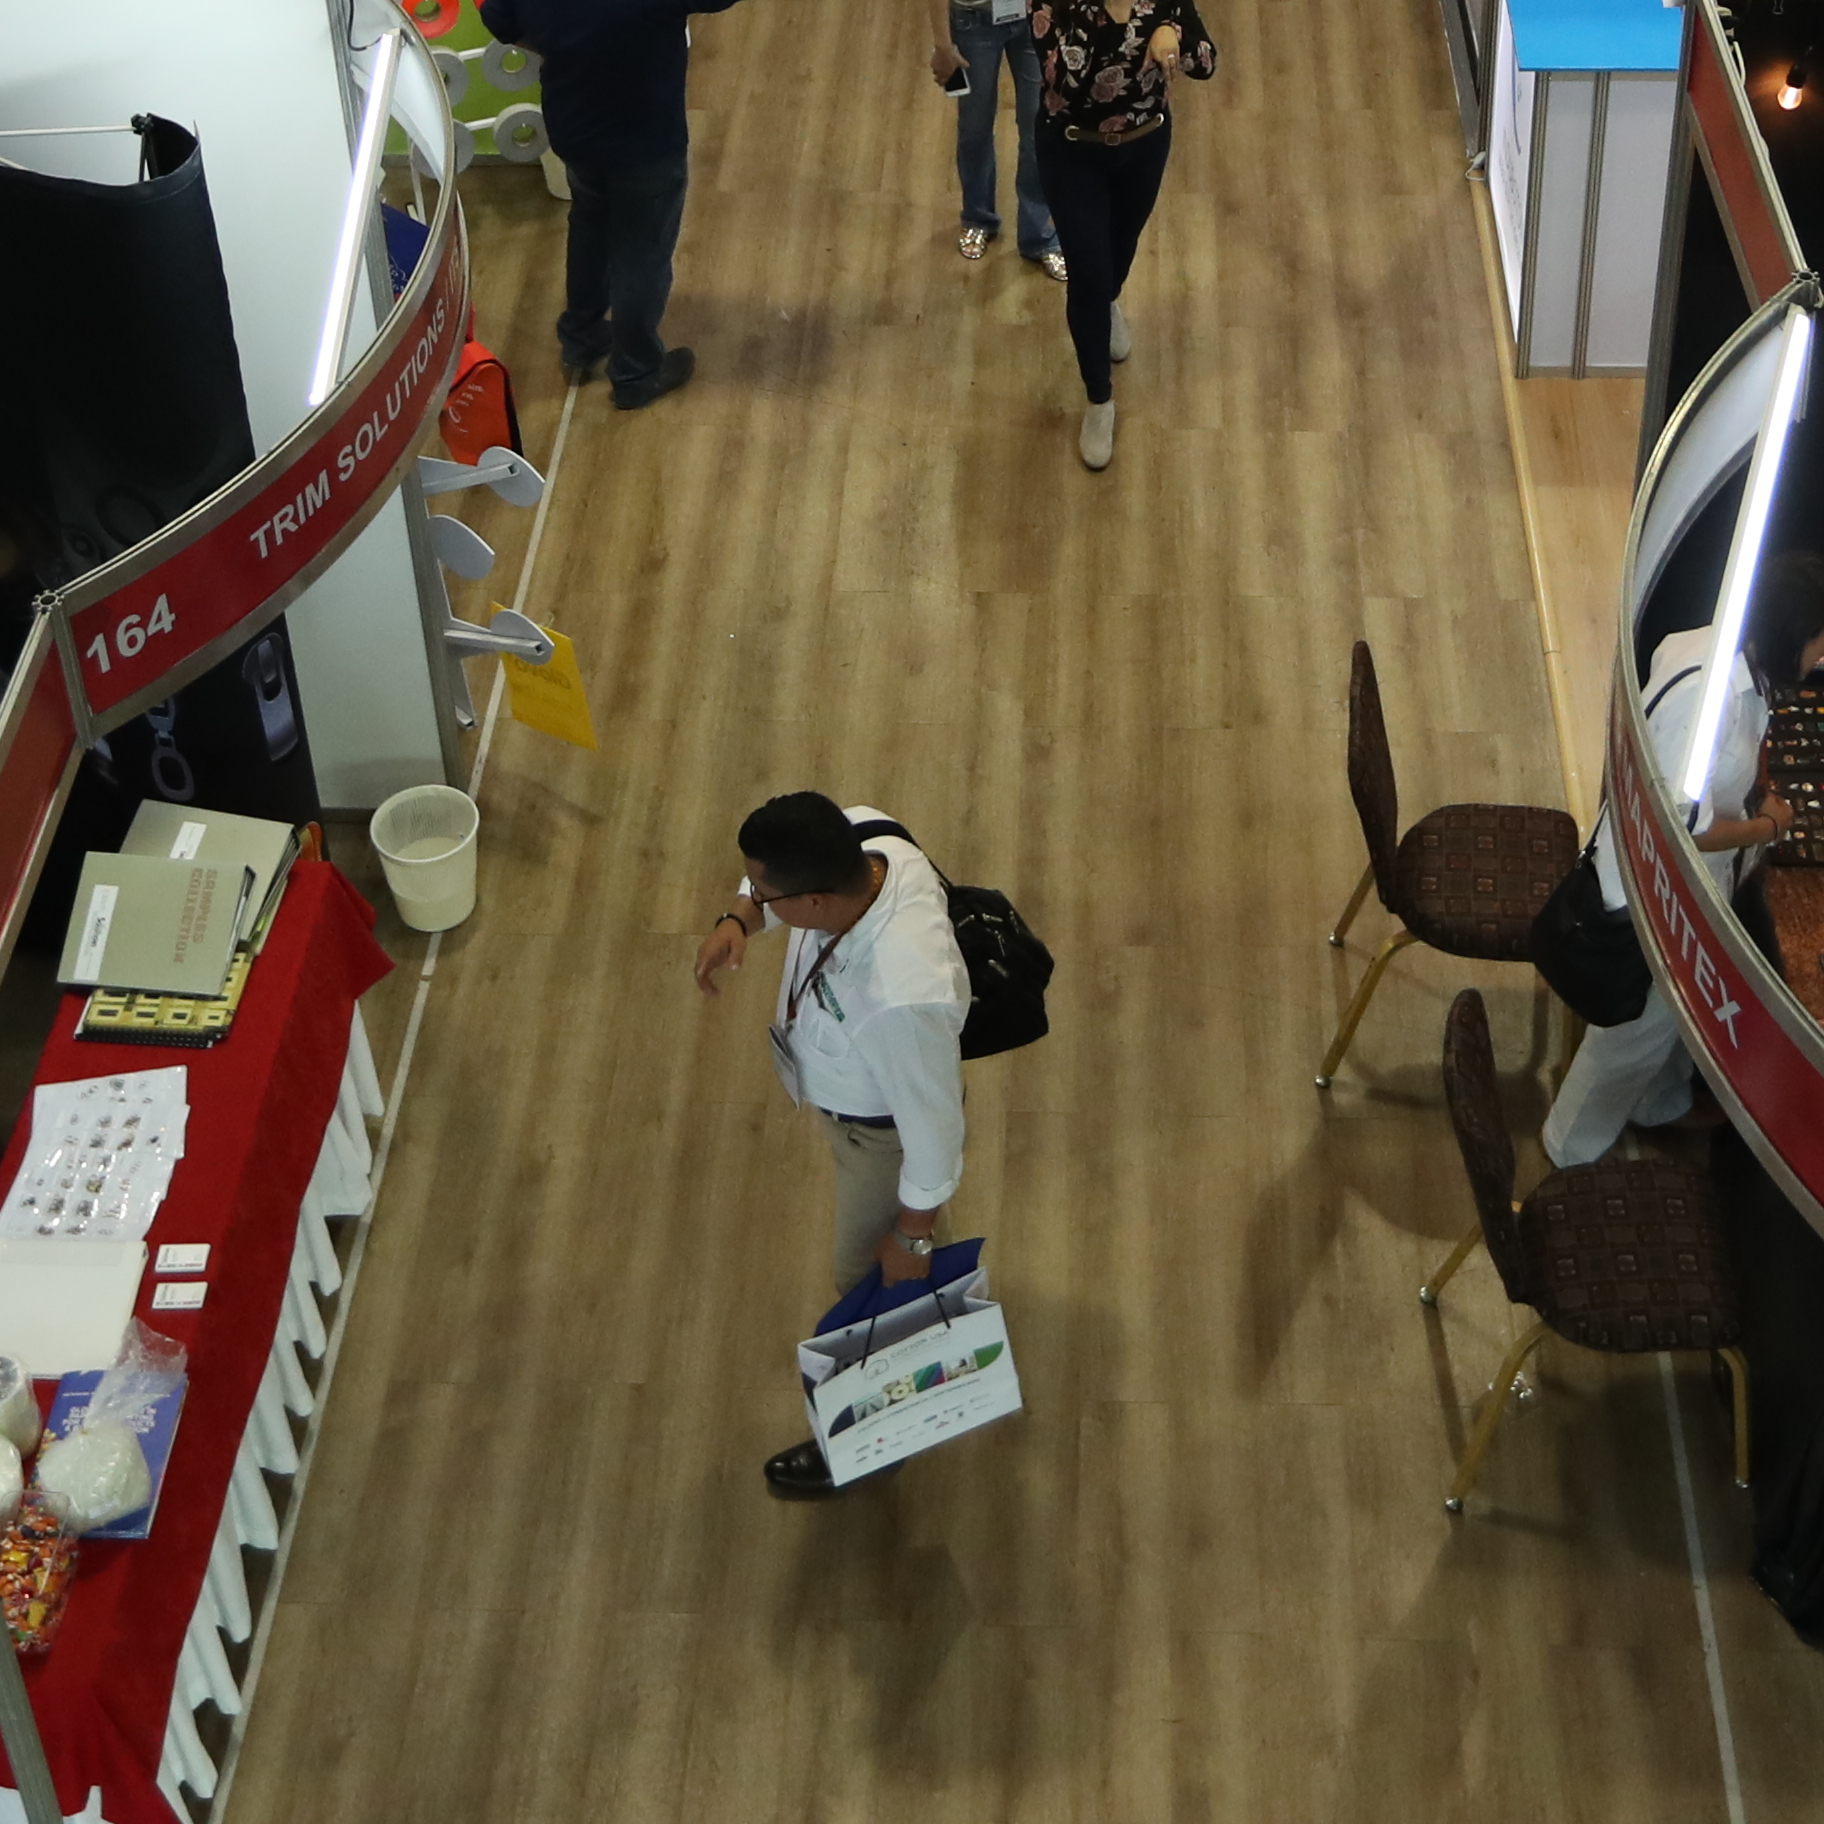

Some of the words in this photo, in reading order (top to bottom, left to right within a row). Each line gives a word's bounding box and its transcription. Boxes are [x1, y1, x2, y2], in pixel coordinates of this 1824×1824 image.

[85, 592, 177, 676] 164
[249, 469, 333, 561] TRIM
[337, 297, 446, 484] SOLUTIONS
[173, 867, 204, 964] COLLECTION
[192, 868, 218, 944] SAMPLES
